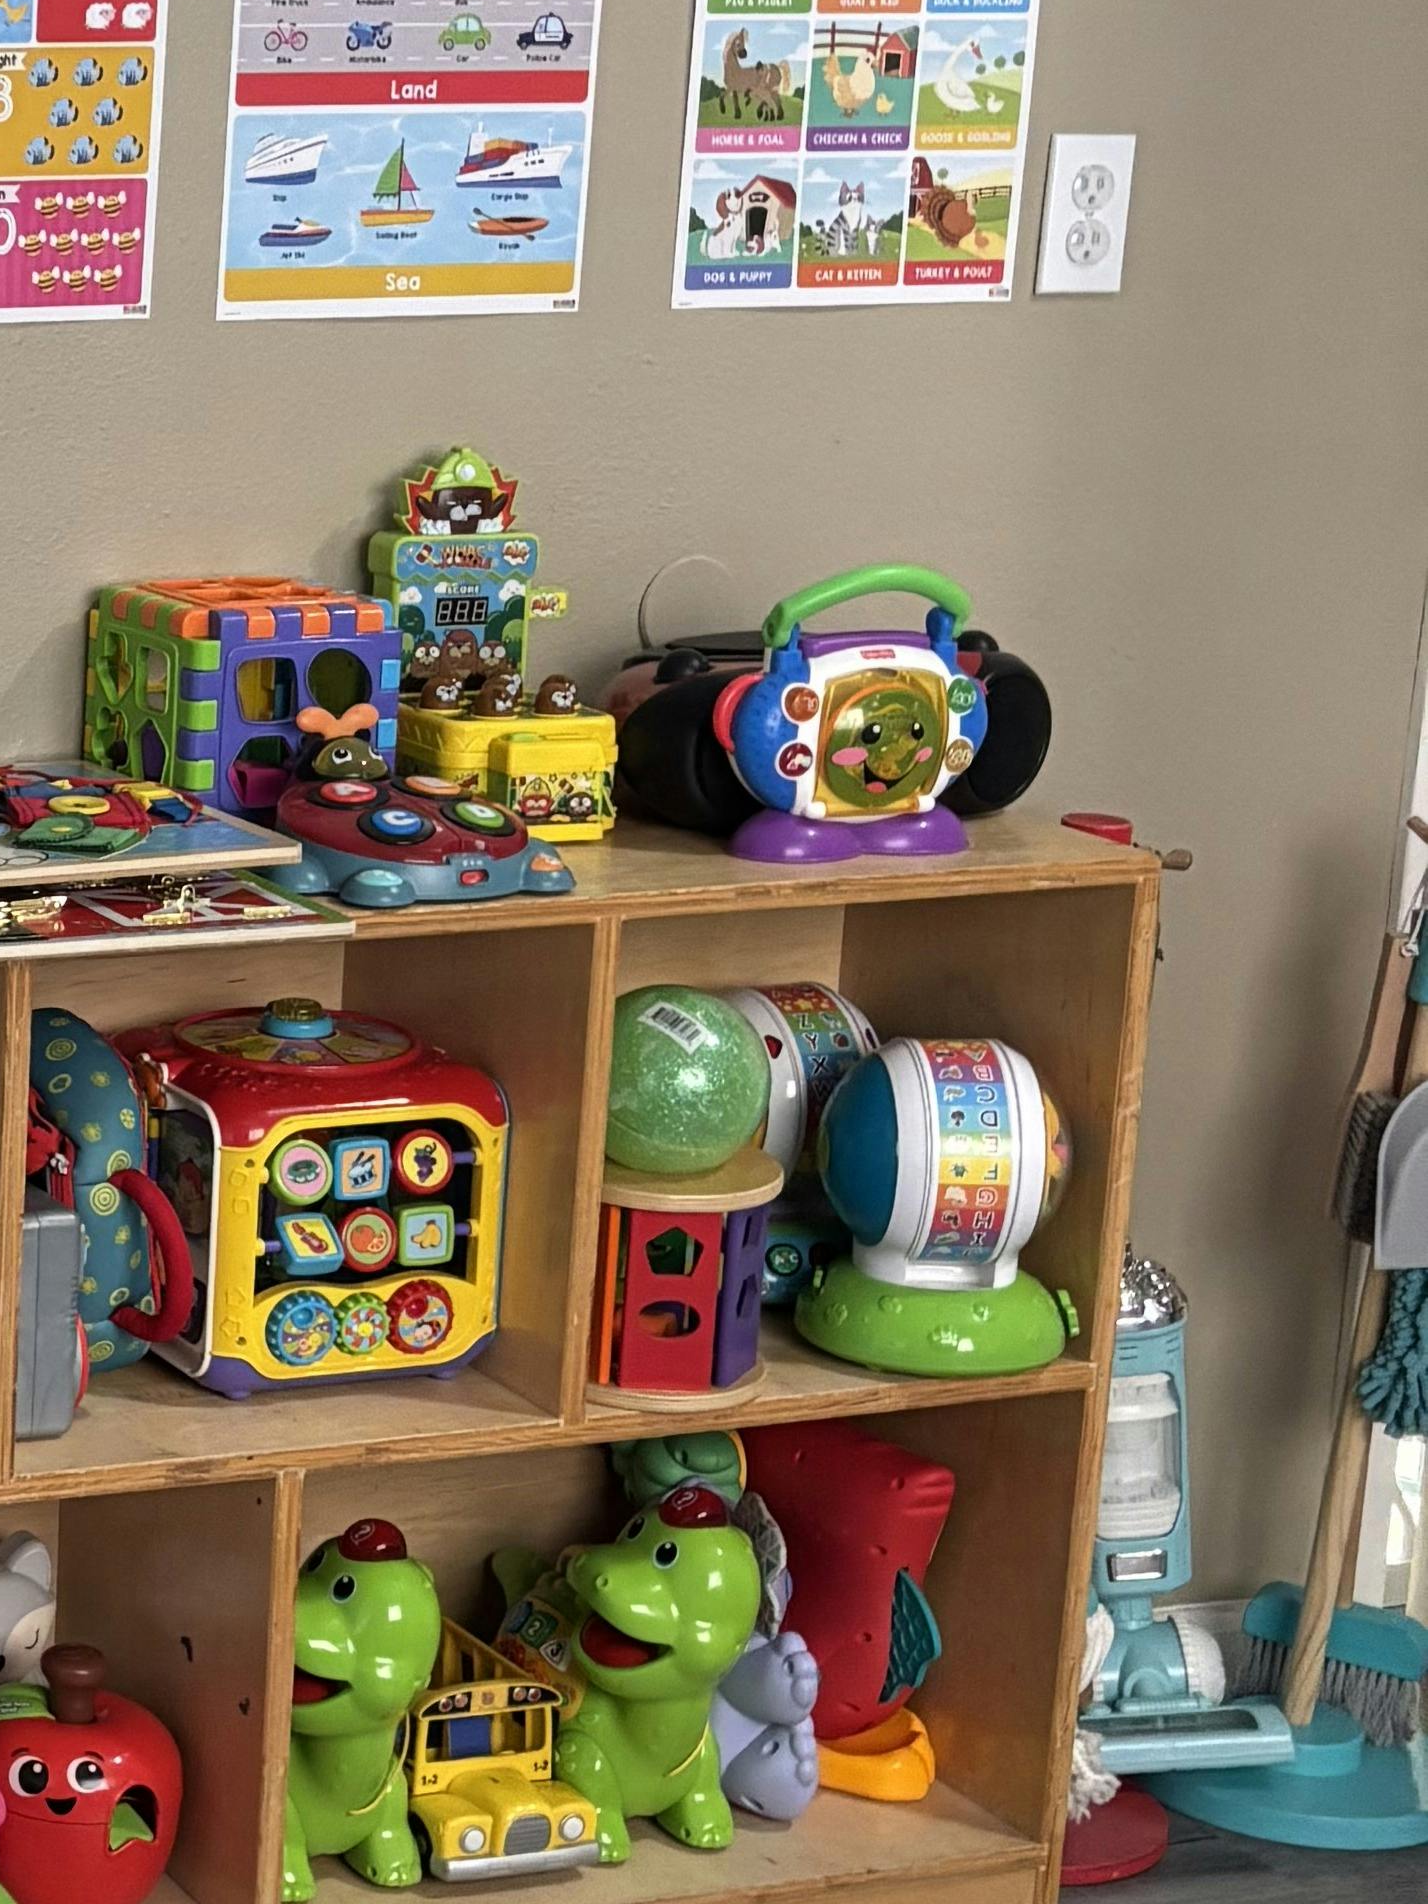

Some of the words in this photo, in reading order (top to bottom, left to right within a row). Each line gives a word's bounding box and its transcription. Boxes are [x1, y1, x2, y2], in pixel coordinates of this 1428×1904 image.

[390, 79, 437, 100] Land
[711, 132, 744, 146] HORSE
[759, 132, 784, 146] FOAL
[813, 131, 855, 146] CHICKEN
[871, 131, 902, 146] CHICK
[703, 271, 723, 283] DOG
[739, 271, 772, 284] PUPPY
[815, 270, 833, 281] CAT
[848, 269, 882, 281] KITTEN
[915, 268, 950, 281] TURKEY
[963, 267, 992, 280] POULT
[385, 272, 420, 292] Sea
